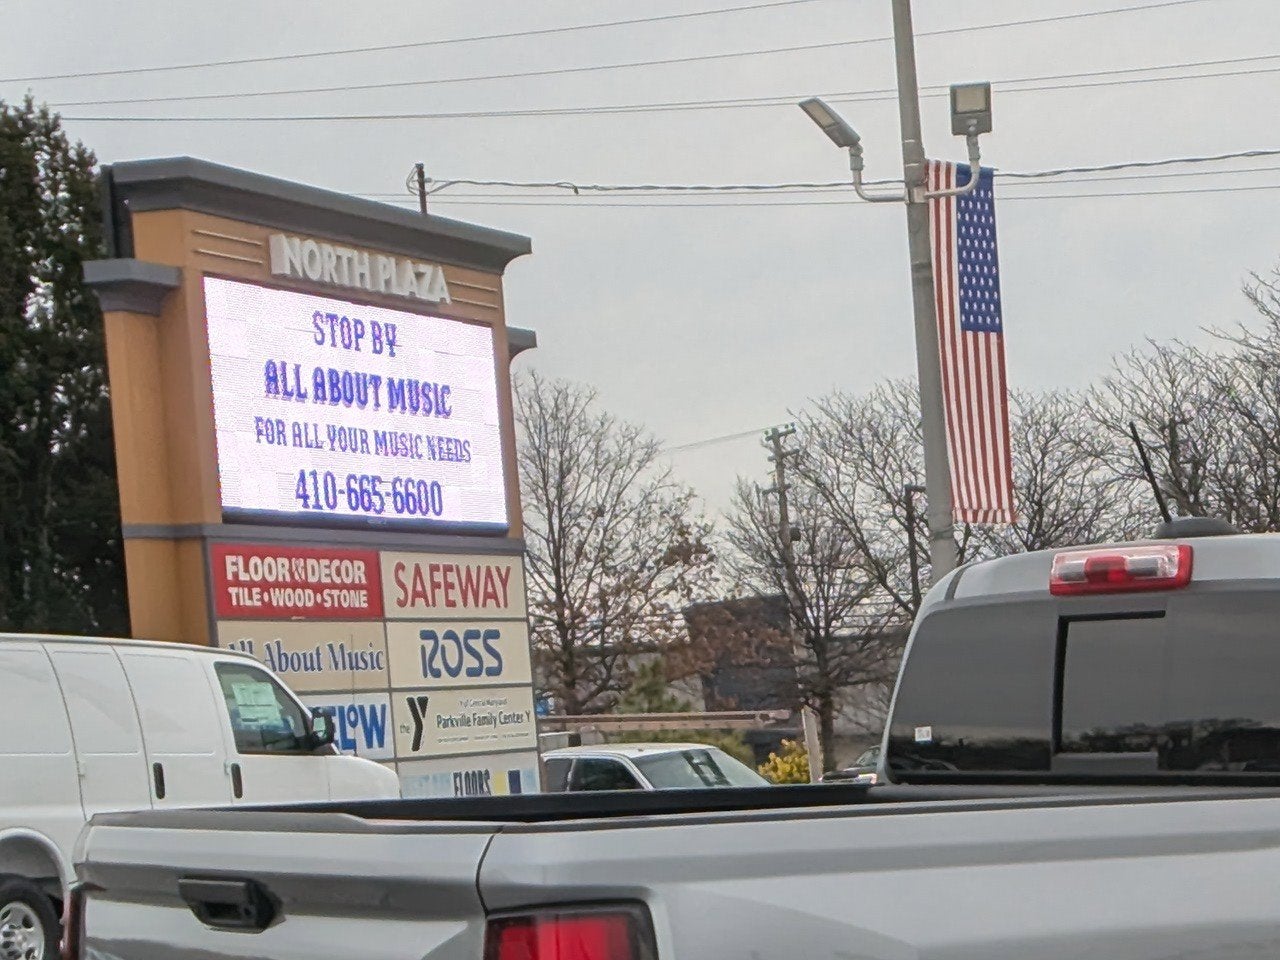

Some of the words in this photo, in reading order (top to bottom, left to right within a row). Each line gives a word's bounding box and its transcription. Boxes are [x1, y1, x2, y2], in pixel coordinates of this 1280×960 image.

[269, 233, 371, 290] NORTH
[374, 255, 452, 304] PLAZA
[312, 310, 366, 352] STOP
[370, 320, 398, 357] BY
[264, 359, 308, 402] ALL
[312, 366, 382, 410] ABOUT
[387, 376, 452, 419] MUSIC
[254, 416, 288, 446] FOR
[292, 421, 324, 450] ALL
[325, 424, 371, 455] YOUR
[373, 429, 423, 460] MUSIC
[426, 435, 472, 463] NEEDS
[295, 469, 444, 517] 410-665-6600
[225, 555, 291, 582] FLOOR
[306, 558, 368, 584] DECOR
[394, 561, 511, 608] SAFEWAY
[228, 586, 263, 607] TILE
[270, 587, 315, 608] WOOD
[322, 589, 369, 609] STONE
[264, 640, 323, 673] About
[327, 641, 385, 672] Music
[419, 628, 503, 678] ROSS
[436, 714, 472, 729] Parkville
[472, 711, 498, 730] Family
[498, 710, 524, 725] Center
[525, 709, 531, 723] Y
